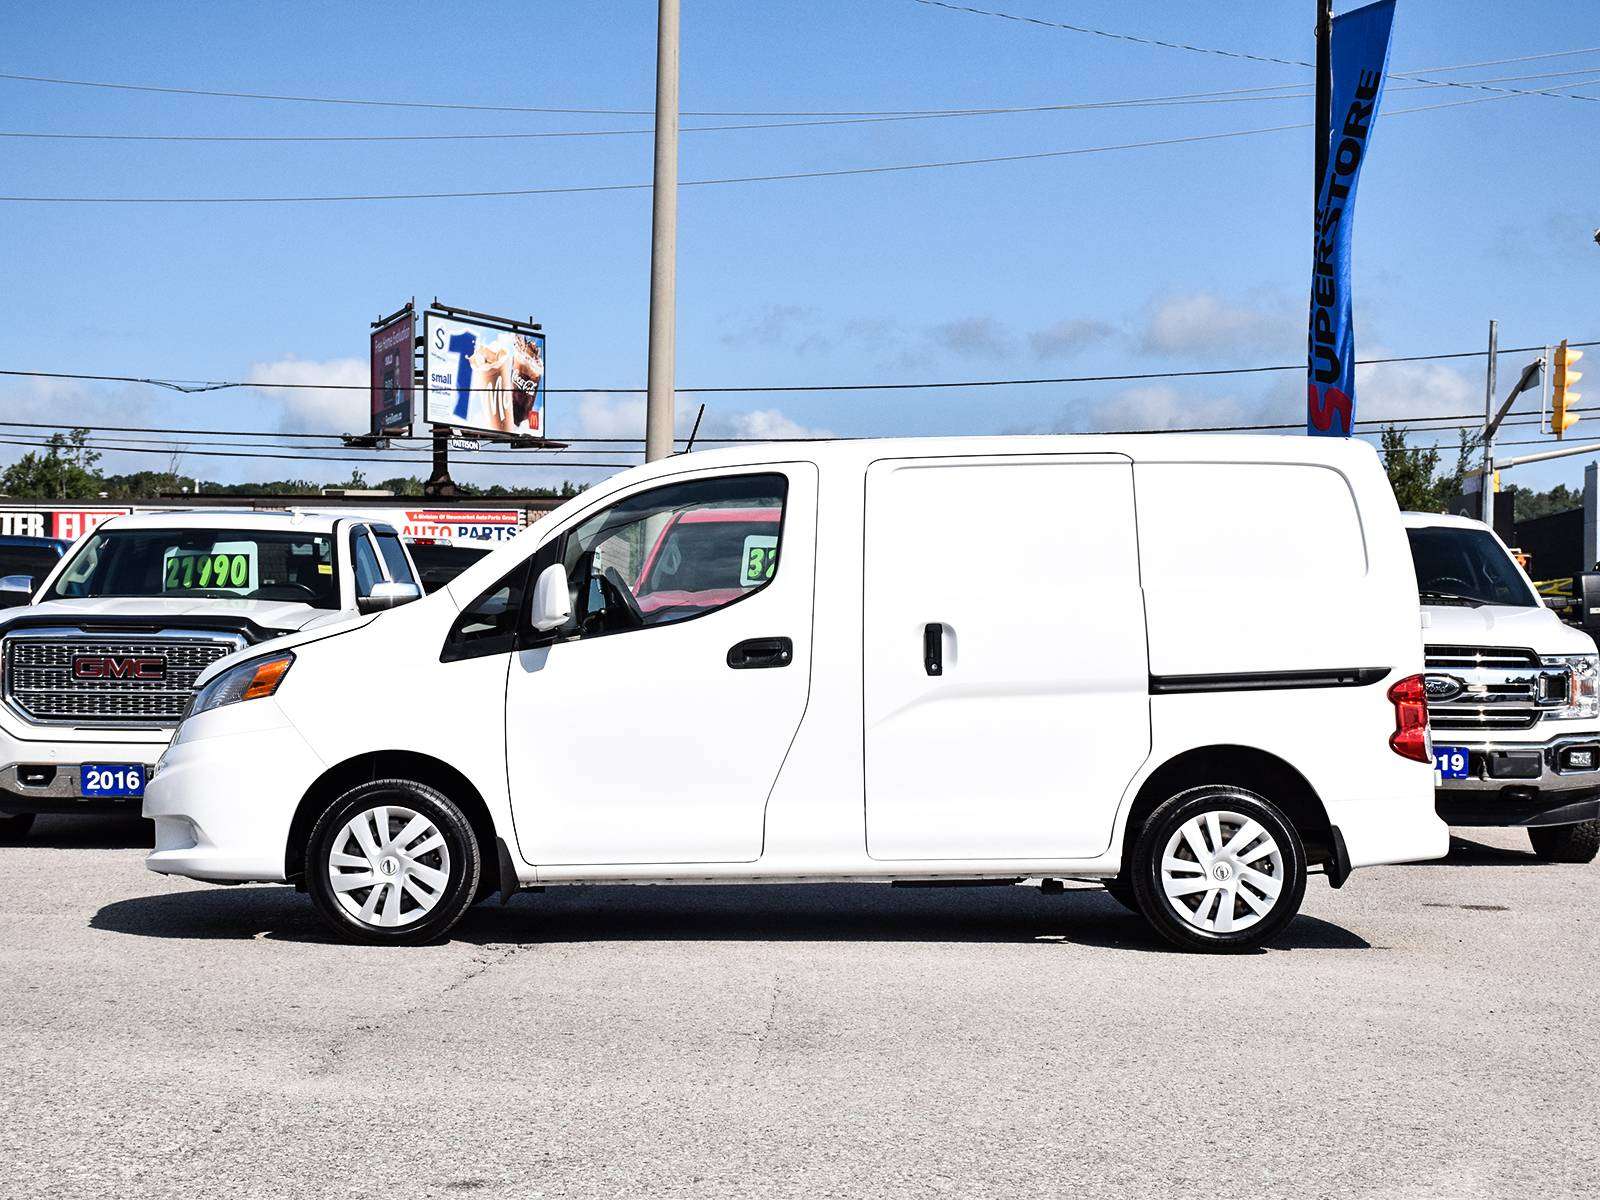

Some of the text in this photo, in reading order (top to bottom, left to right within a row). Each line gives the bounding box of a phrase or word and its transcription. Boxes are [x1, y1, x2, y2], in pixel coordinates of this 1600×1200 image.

[1309, 68, 1380, 432] SUPERSTORE
[431, 372, 452, 385] small
[402, 525, 517, 541] AUTO PARTS
[75, 657, 163, 678] GMC
[1431, 753, 1464, 771] 19
[86, 771, 140, 790] 2016
